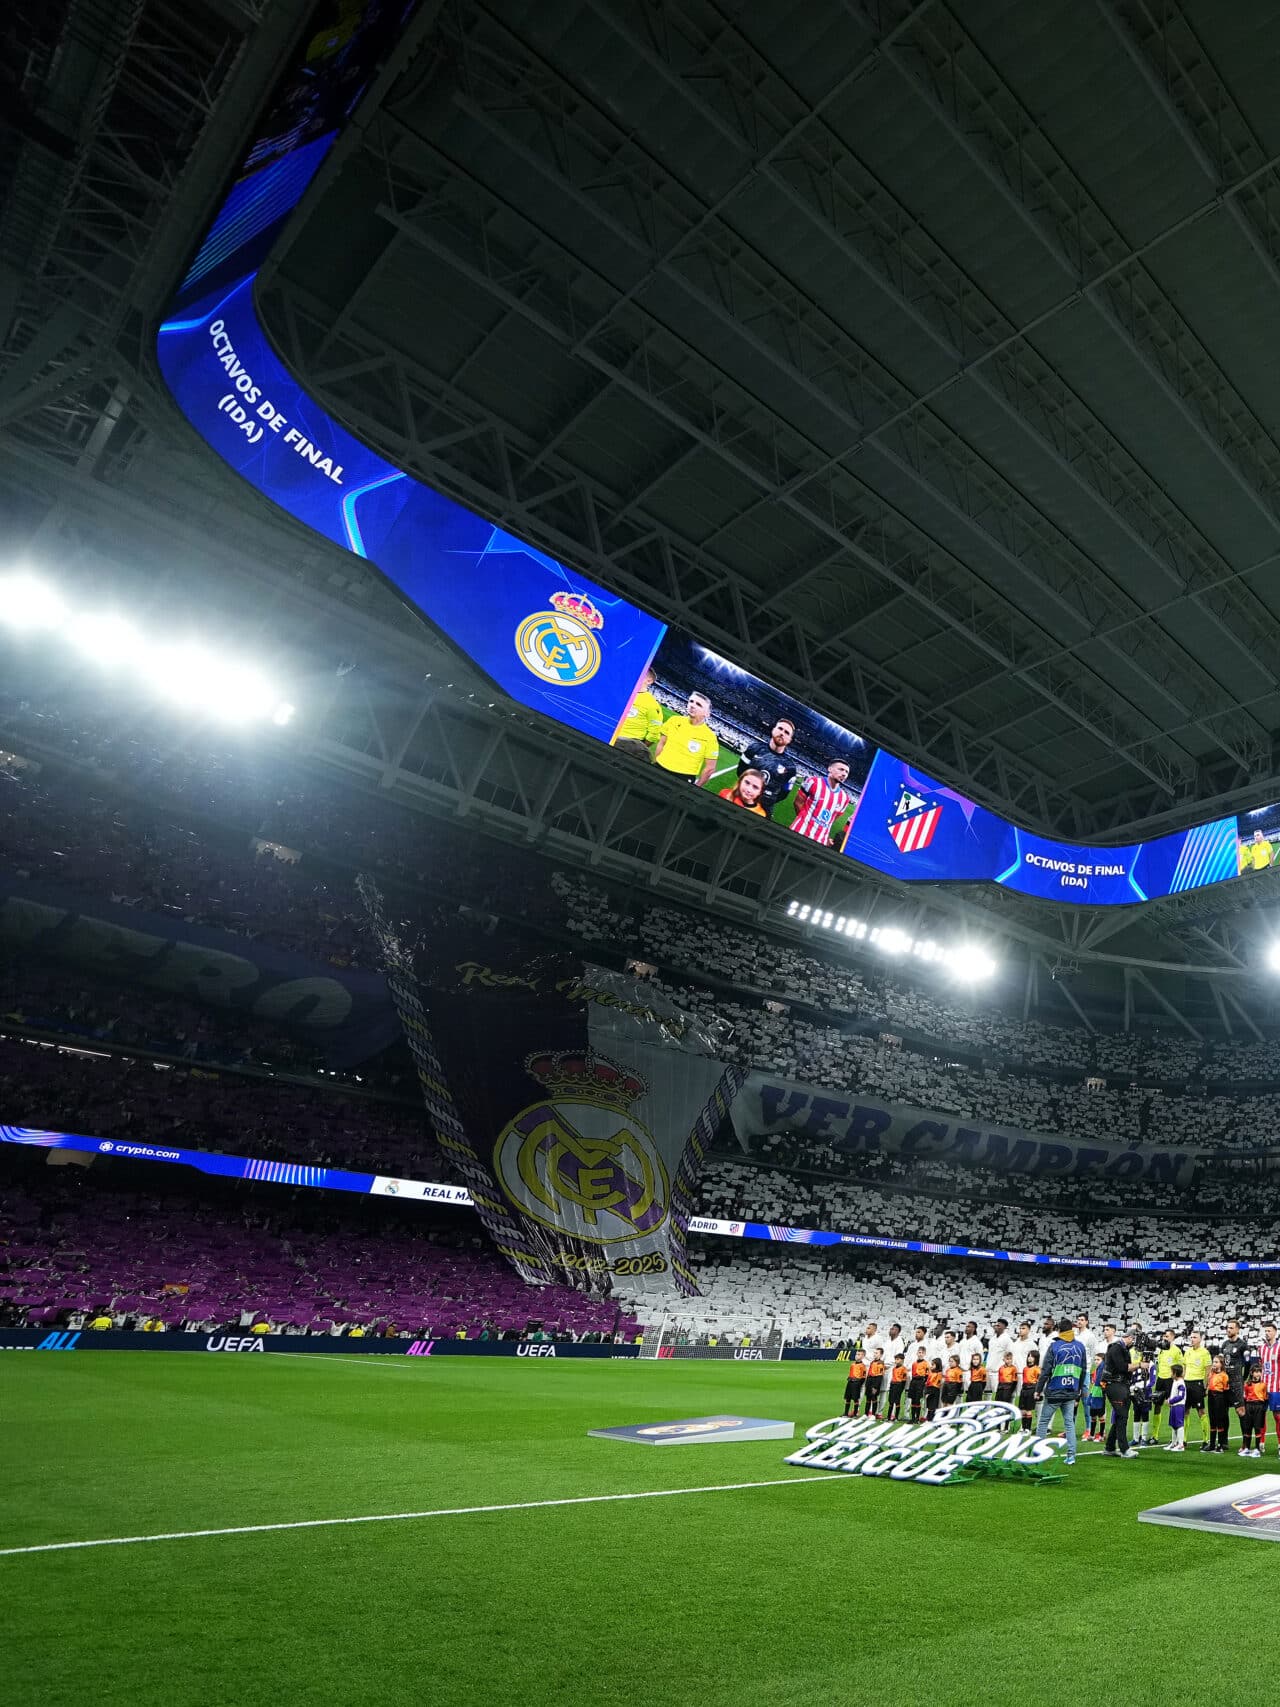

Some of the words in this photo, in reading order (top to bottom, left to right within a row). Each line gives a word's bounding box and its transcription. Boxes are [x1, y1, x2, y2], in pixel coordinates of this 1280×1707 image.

[209, 319, 262, 404] OCTAVOS
[256, 400, 288, 433] DE
[283, 428, 344, 485] FINAL
[217, 394, 264, 444] (IDA)
[1025, 853, 1075, 873] OCTAVOS
[1077, 864, 1093, 875] DE
[1094, 864, 1126, 876] FINAL
[1060, 875, 1088, 889] (IDA)
[760, 1085, 895, 1151] VER
[900, 1119, 1189, 1184] CAMPEÓN
[115, 1144, 180, 1159] crypto.com
[423, 1187, 452, 1199] REAL
[856, 1237, 887, 1246] CHAMPIONS
[888, 1241, 909, 1249] LEAGUE
[36, 1332, 82, 1350] ALL
[206, 1336, 265, 1352] UEFA
[405, 1341, 435, 1356] ALL
[516, 1344, 556, 1357] UEFA
[733, 1348, 763, 1360] UEFA
[836, 1350, 852, 1361] ALL
[804, 1416, 1069, 1465] CHAMPIONS
[782, 1438, 973, 1486] LEAGUE
